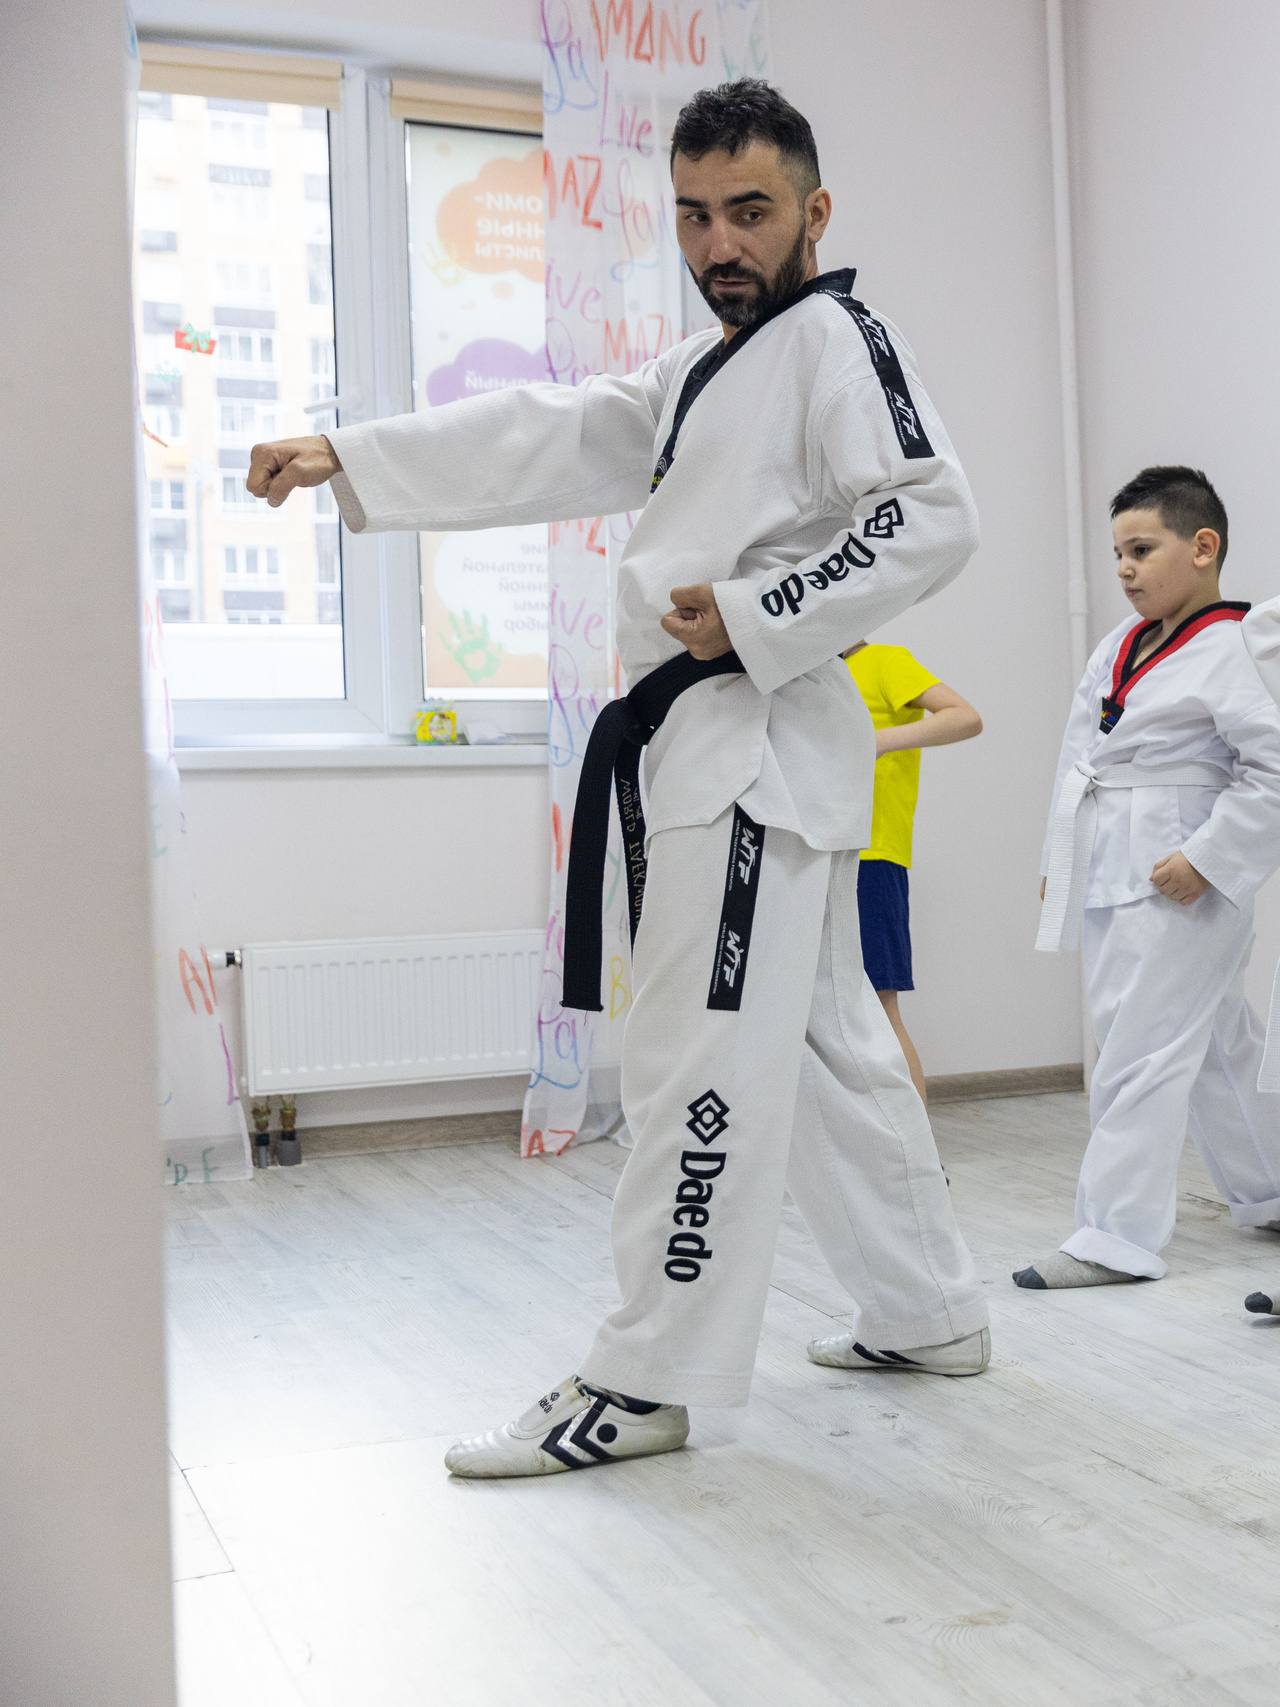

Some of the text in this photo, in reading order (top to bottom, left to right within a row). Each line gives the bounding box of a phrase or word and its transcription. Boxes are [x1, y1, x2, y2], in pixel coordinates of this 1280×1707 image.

[761, 531, 876, 618] Daedo
[738, 827, 759, 885] WTF
[723, 929, 745, 988] WTF
[664, 1150, 727, 1283] Daedo
